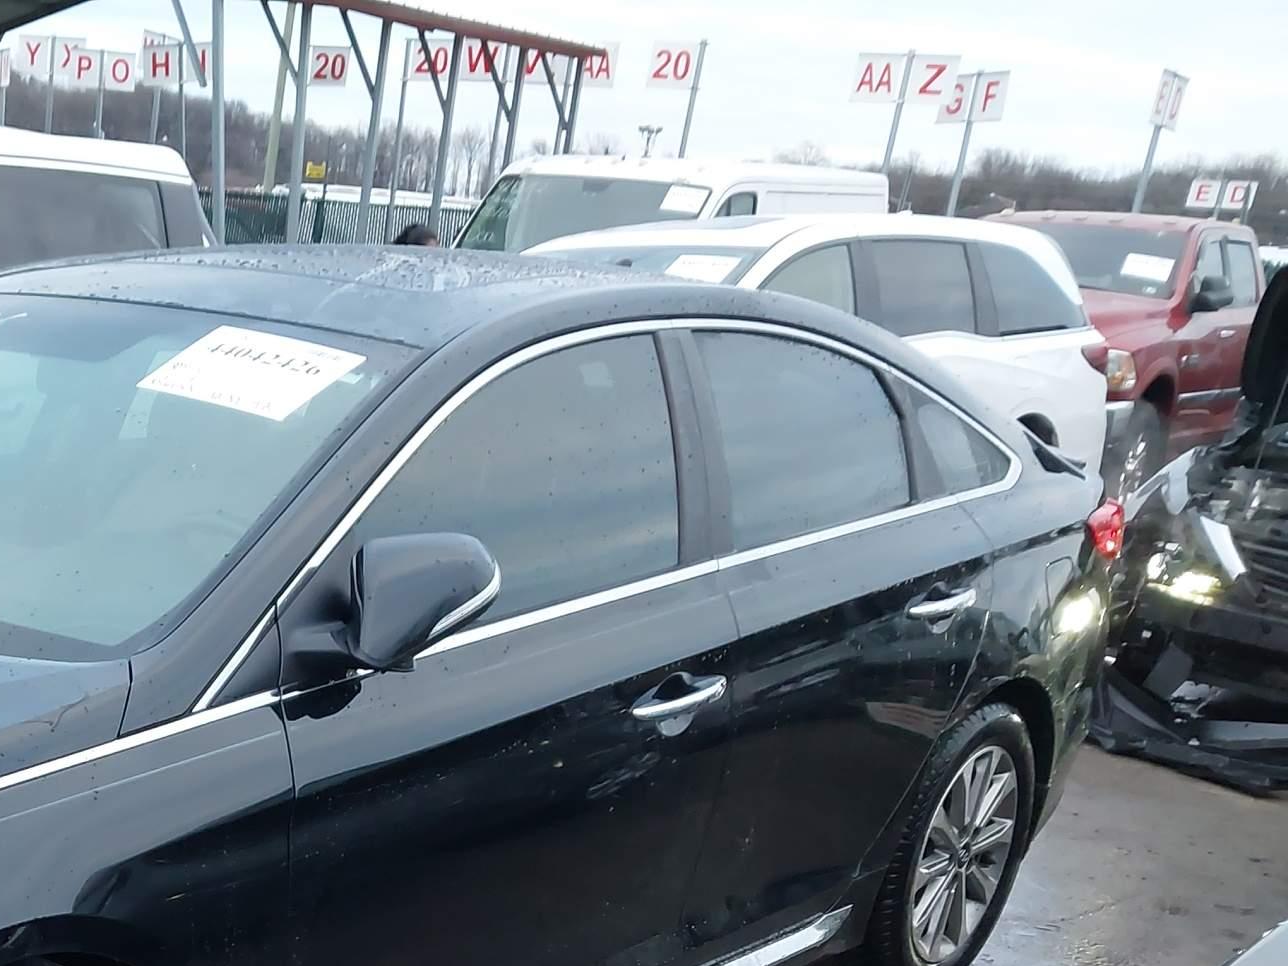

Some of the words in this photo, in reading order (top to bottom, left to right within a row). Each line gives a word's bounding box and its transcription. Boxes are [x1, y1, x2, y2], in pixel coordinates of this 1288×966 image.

[26, 42, 42, 66] Y
[76, 55, 92, 80] P
[152, 51, 170, 78] H
[313, 52, 346, 80] 20
[415, 47, 448, 74] 20
[468, 45, 500, 73] W
[652, 49, 692, 81] 20
[856, 62, 892, 93] AA
[918, 63, 948, 95] Z
[981, 80, 1001, 113] F
[1194, 184, 1212, 202] E
[1229, 185, 1248, 204] D
